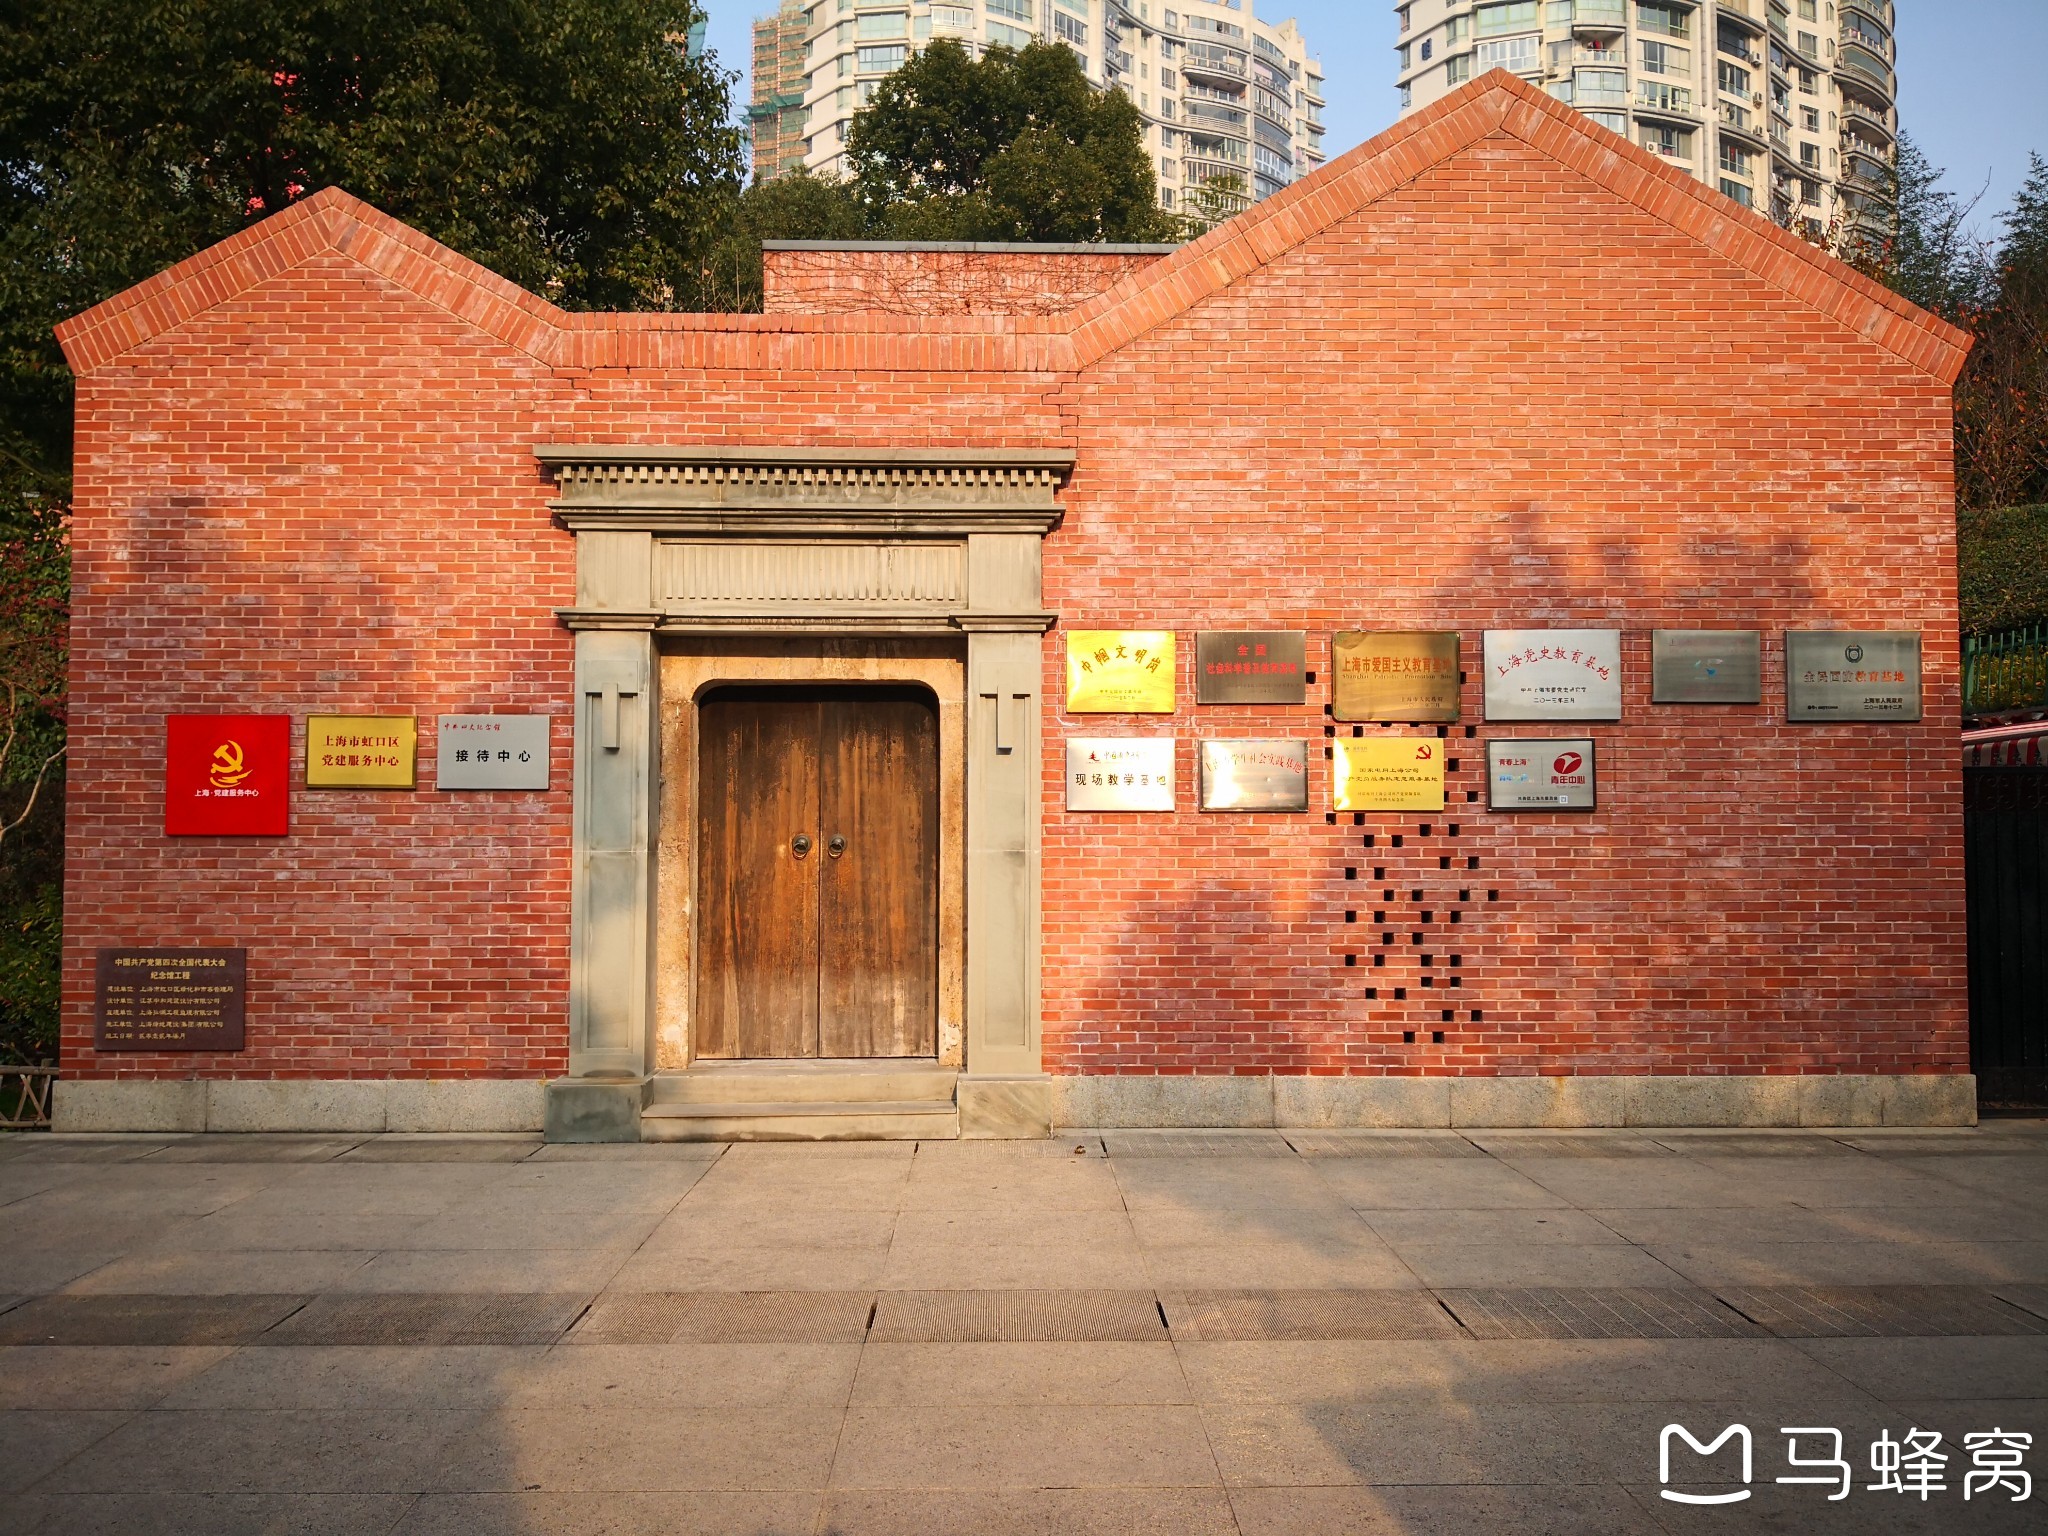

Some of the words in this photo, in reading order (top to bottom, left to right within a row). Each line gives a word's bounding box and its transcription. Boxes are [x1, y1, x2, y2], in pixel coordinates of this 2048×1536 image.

[1237, 643, 1267, 656] 全国
[1081, 644, 1161, 674] 巾帼文明岗
[1342, 656, 1452, 673] 上海市爱国主义教育基地
[1497, 645, 1610, 681] 上海党史教育基地
[1804, 670, 1905, 683] 全民国防教育基地
[323, 735, 399, 747] 上海市虹口区
[322, 754, 399, 766] 党建服务中心
[456, 749, 531, 763] 接待中心
[1075, 773, 1166, 786] 现场教学基地
[1551, 775, 1586, 785] 青年中心
[194, 788, 260, 797] 上海·党建服务中心
[114, 957, 227, 967] 中国共产党第四次全国代表大会
[150, 971, 190, 980] 纪念馆工程
